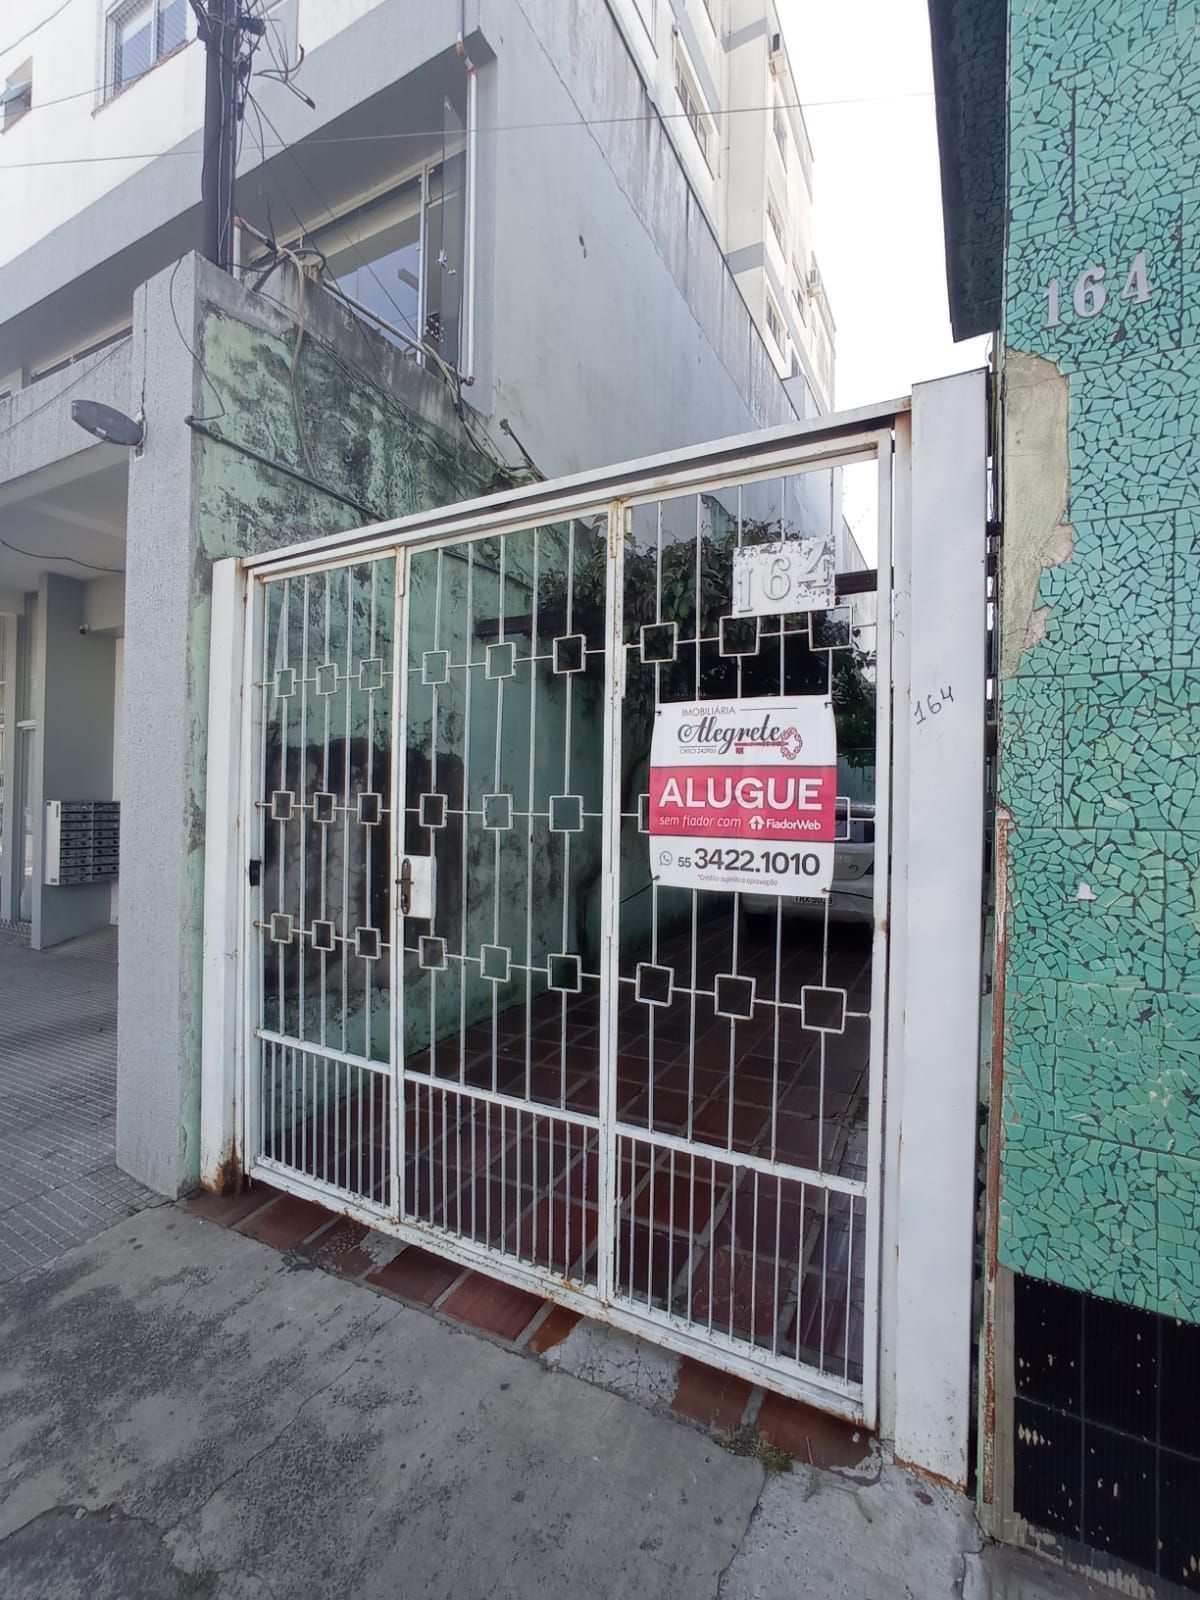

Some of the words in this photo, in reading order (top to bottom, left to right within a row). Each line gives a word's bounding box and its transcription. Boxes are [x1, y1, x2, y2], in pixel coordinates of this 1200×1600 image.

[1042, 249, 1152, 329] 164
[736, 540, 835, 613] 164
[681, 704, 736, 716] IMOBILIÁRIA
[913, 685, 954, 725] 164
[677, 713, 782, 755] Alegrete
[658, 777, 823, 811] ALUGUE
[659, 817, 679, 826] sem
[682, 814, 715, 828] fiador
[717, 818, 741, 828] com
[766, 818, 821, 831] FiadorWeb
[678, 857, 691, 868] 55
[694, 847, 820, 876] 3422.1010
